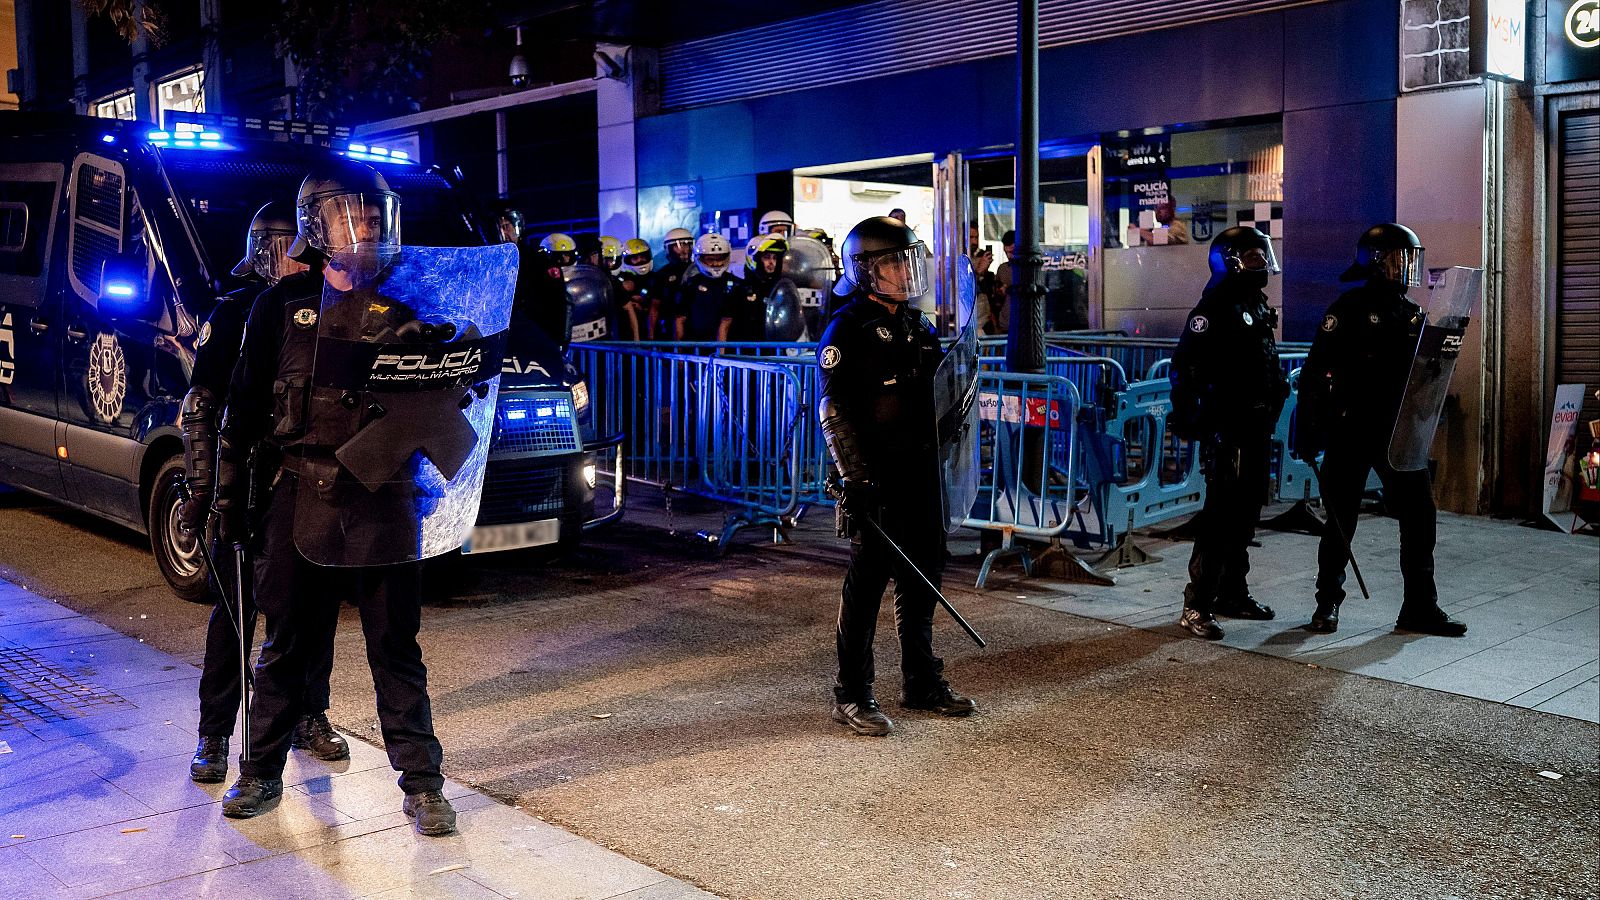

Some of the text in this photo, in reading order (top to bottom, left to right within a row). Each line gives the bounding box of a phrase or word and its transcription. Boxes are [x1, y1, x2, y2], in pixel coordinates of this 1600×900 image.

[1490, 15, 1520, 46] MSM
[1134, 181, 1168, 192] POLICÍA
[1139, 195, 1169, 205] madrid
[372, 347, 482, 370] POLICÍA
[430, 365, 479, 379] MADRID
[1555, 409, 1579, 423] evian
